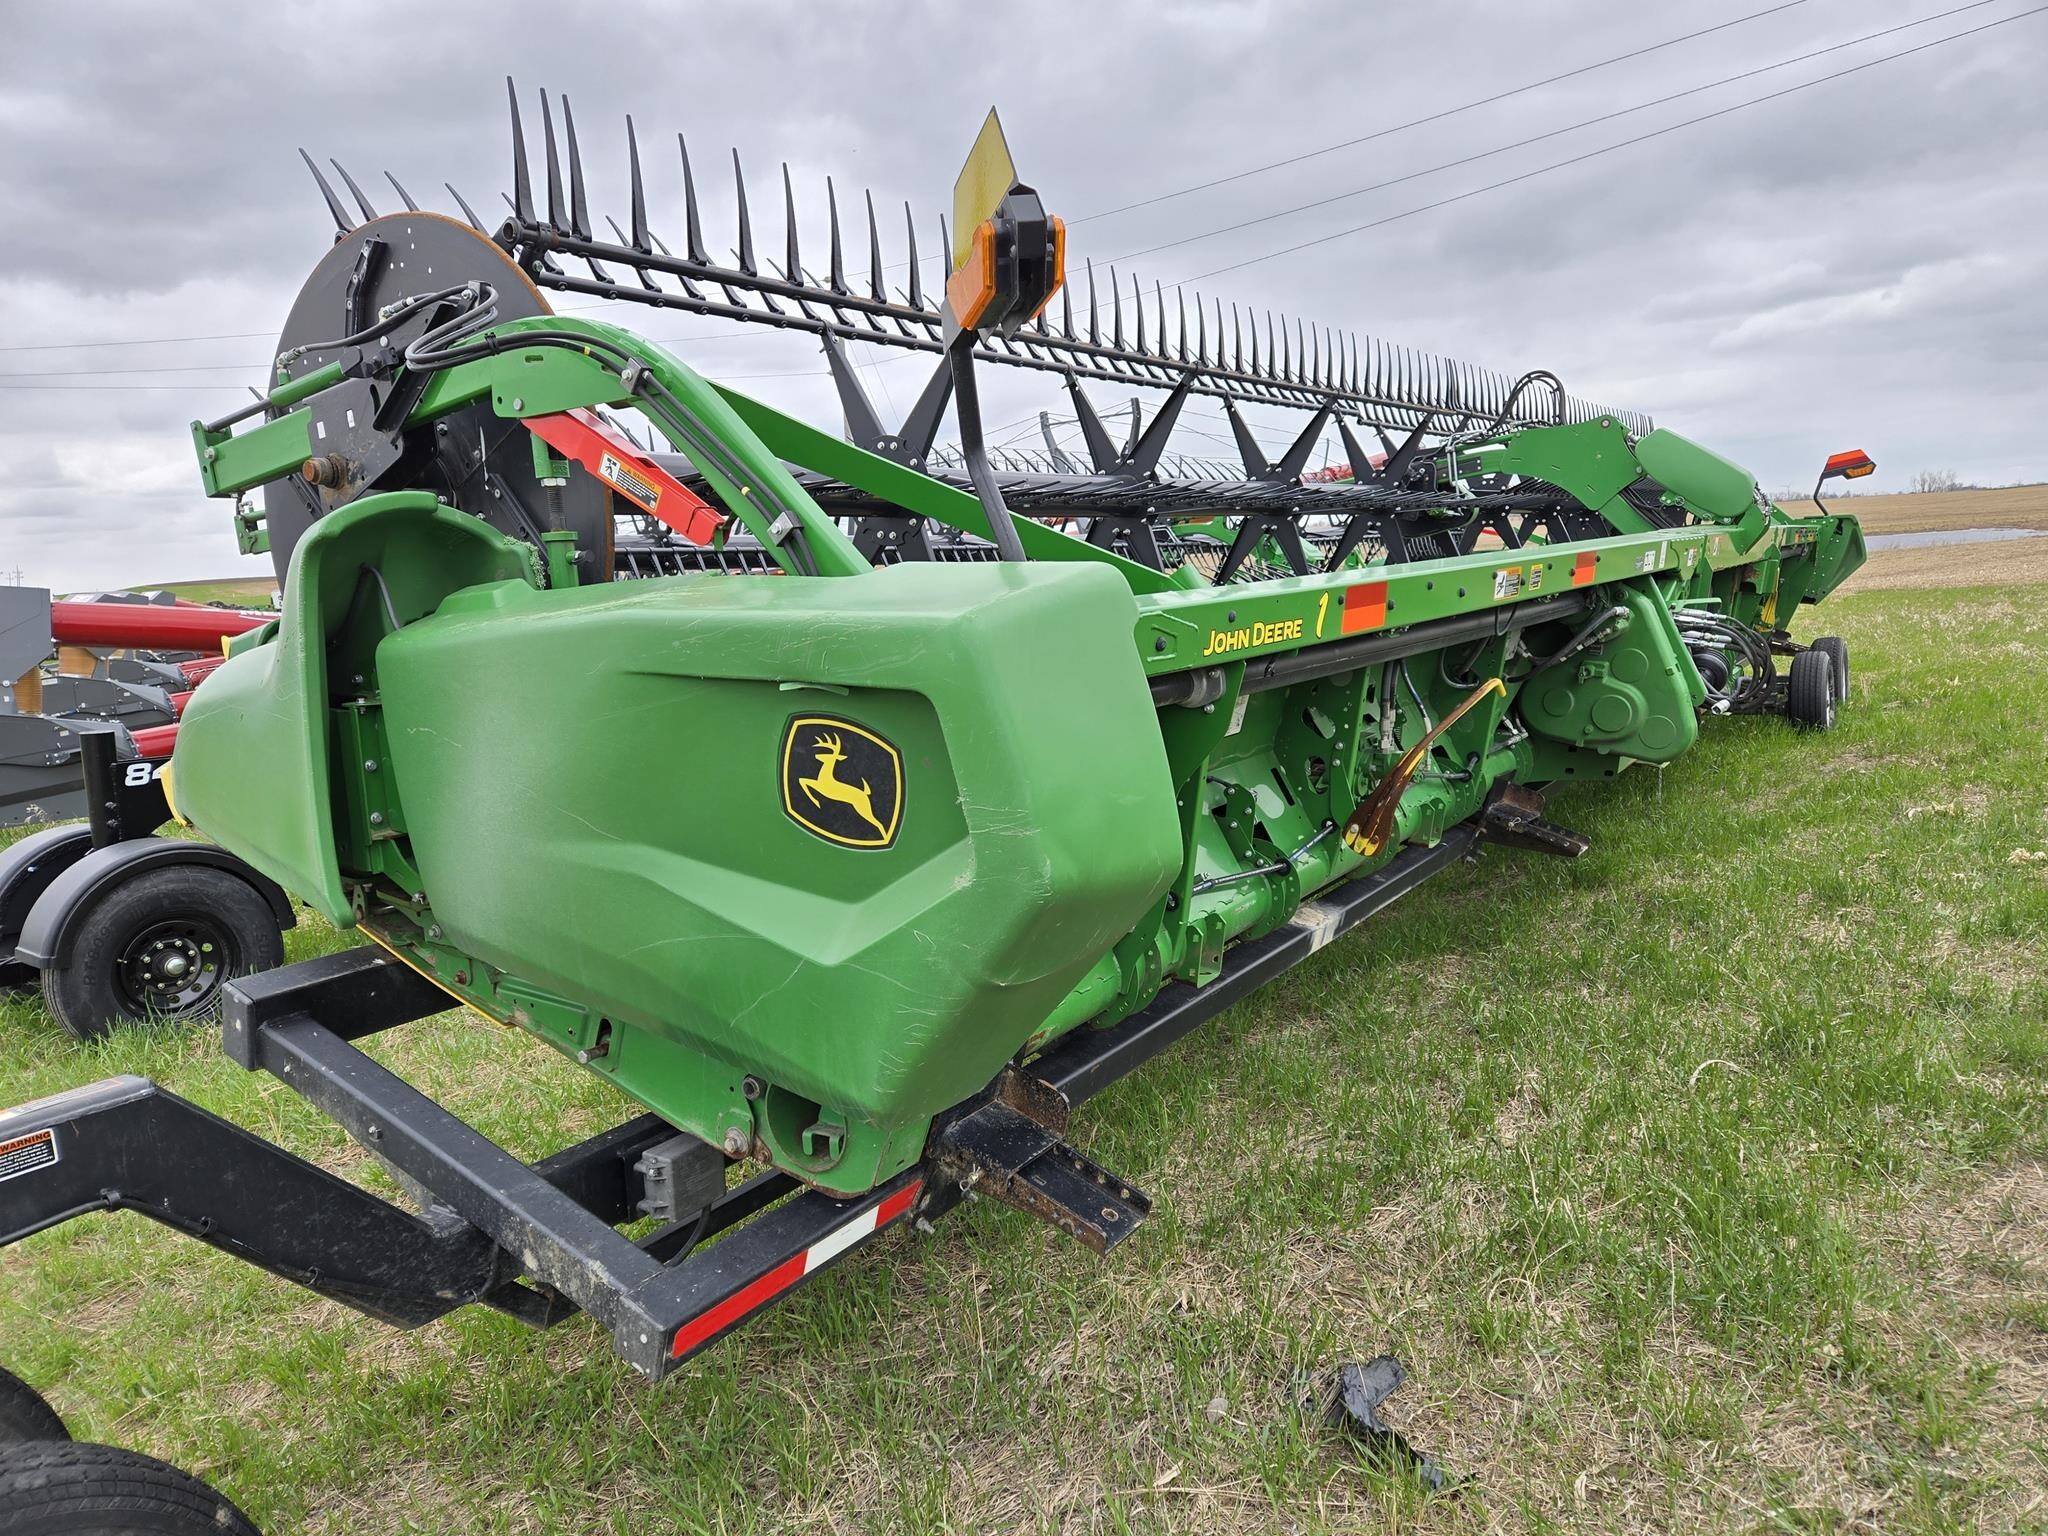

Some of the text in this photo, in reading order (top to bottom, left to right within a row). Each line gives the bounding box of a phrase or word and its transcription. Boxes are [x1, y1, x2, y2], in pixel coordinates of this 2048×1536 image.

[1316, 591, 1329, 639] 1
[1203, 618, 1303, 657] JOHN DEERE
[0, 1131, 51, 1152] WARNING
